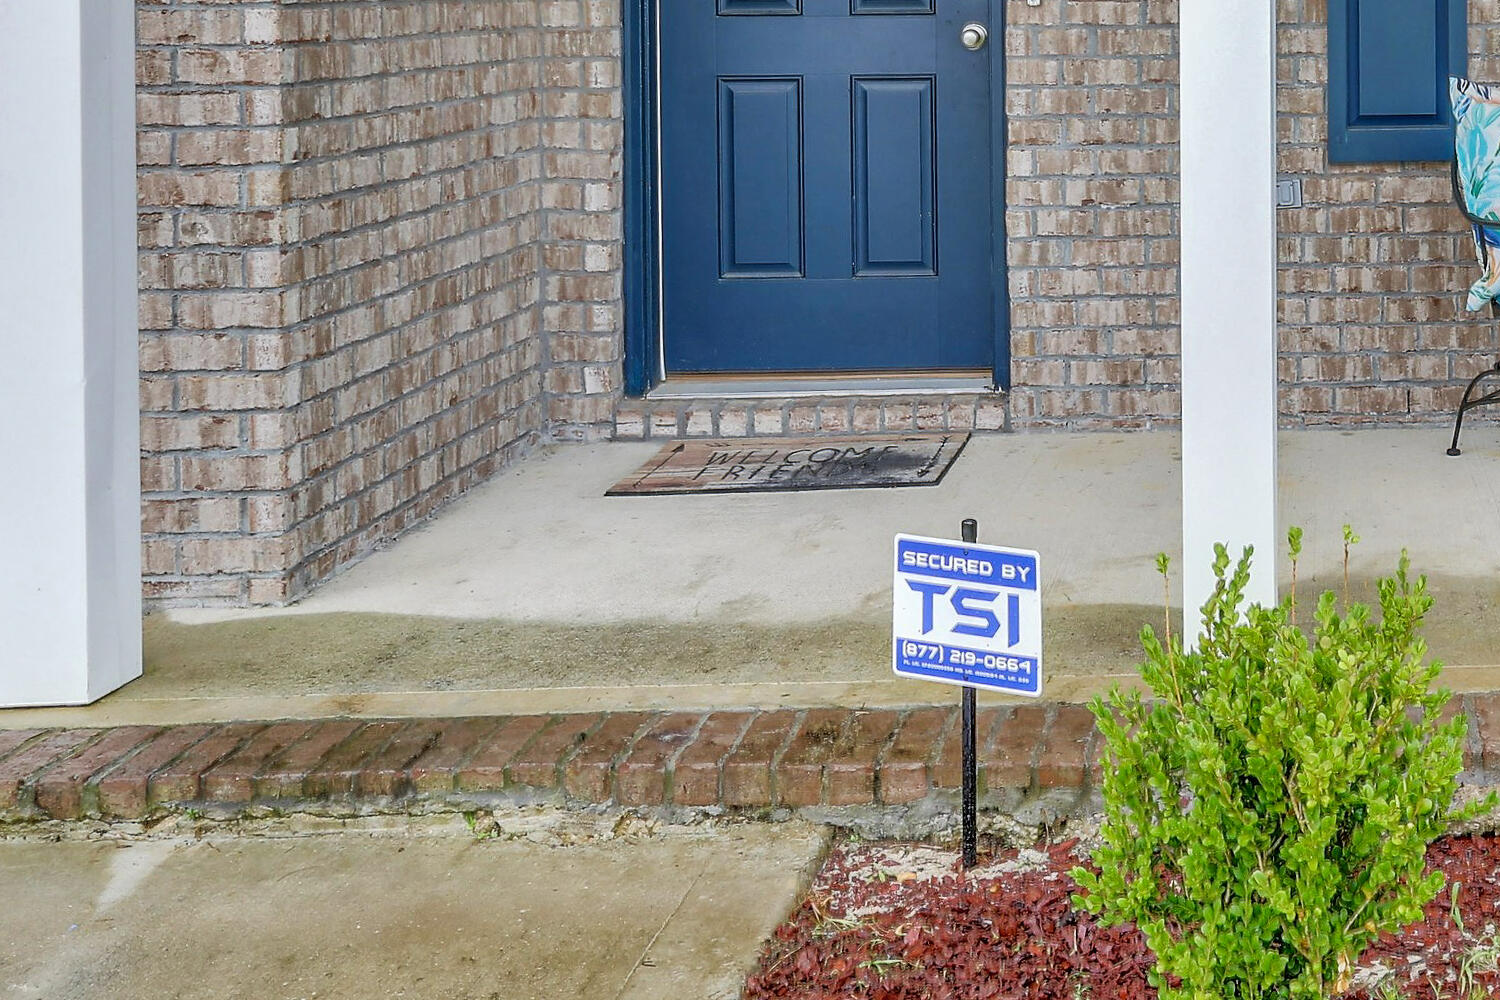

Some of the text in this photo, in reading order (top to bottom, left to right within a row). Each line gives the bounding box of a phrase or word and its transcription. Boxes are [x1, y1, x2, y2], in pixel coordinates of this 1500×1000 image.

[706, 445, 899, 466] WELCOME
[903, 551, 1031, 582] SECURED BY
[905, 578, 1019, 648] TSI
[902, 641, 944, 663] (877)
[951, 650, 1031, 674] 219-0664
